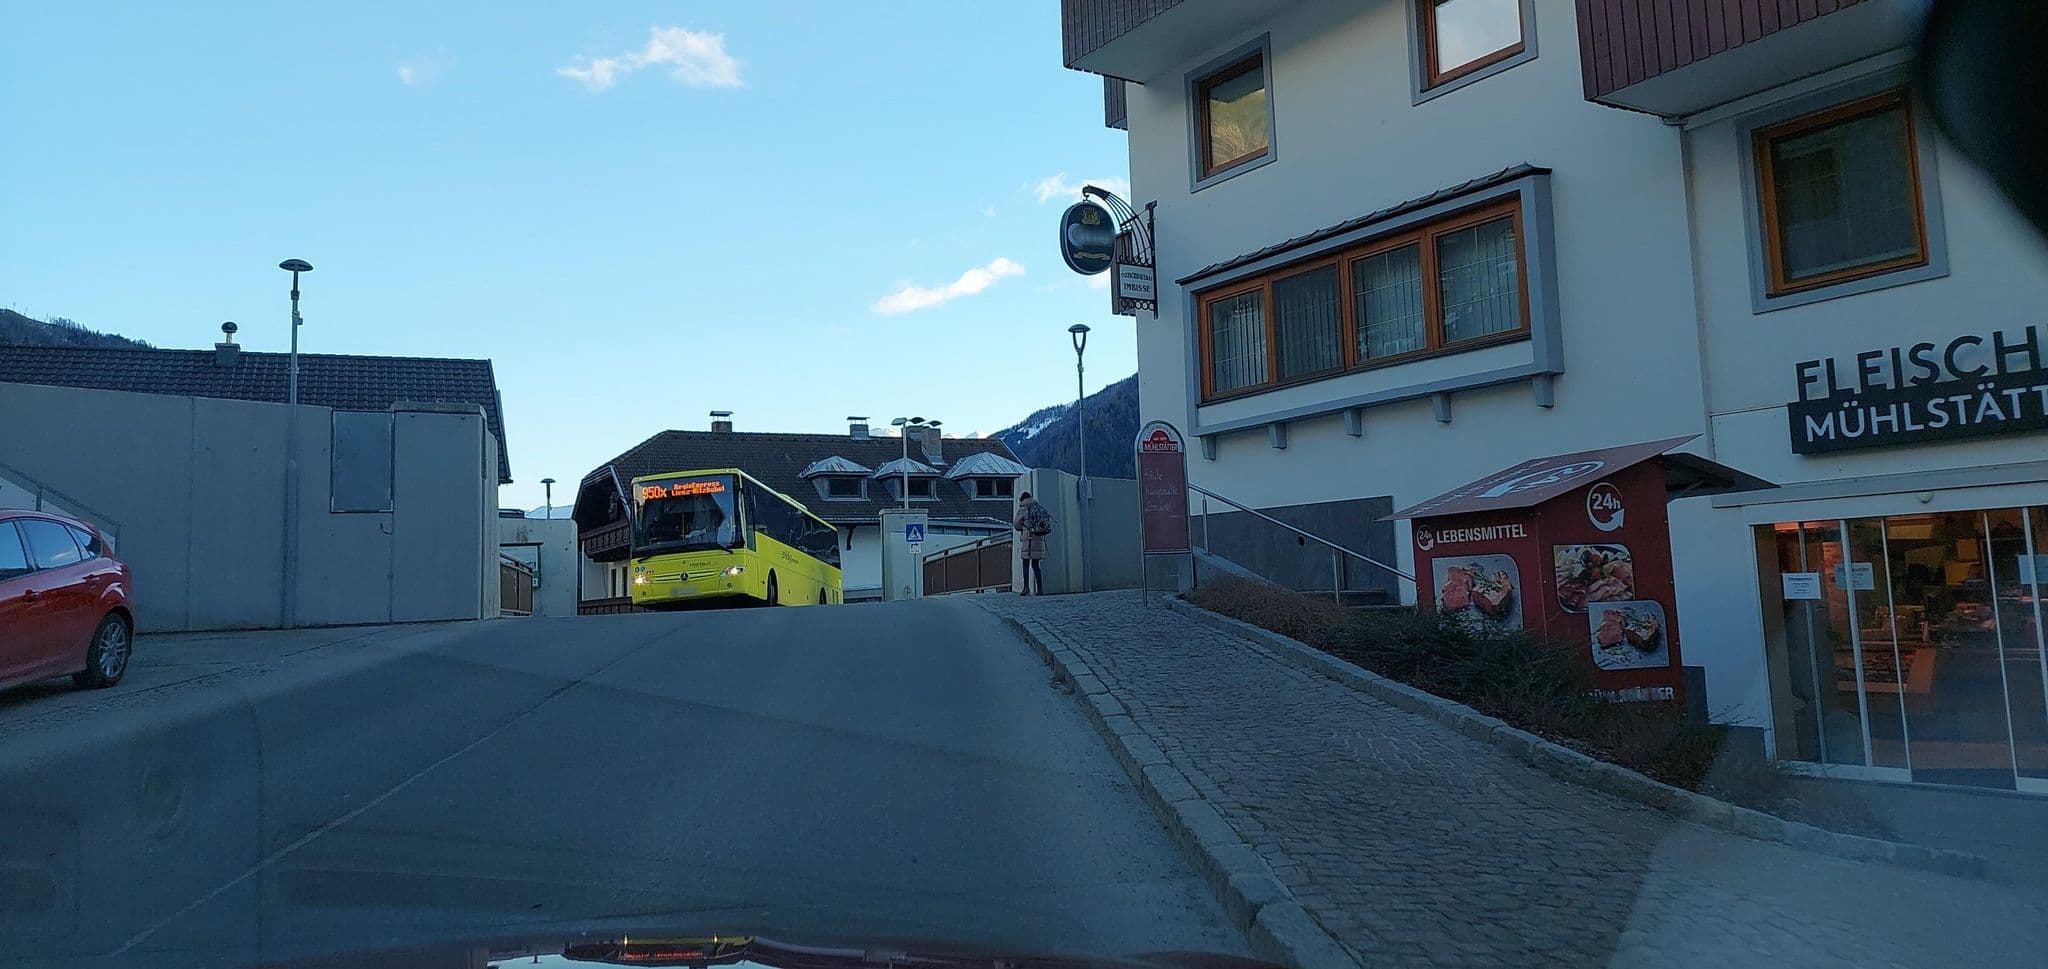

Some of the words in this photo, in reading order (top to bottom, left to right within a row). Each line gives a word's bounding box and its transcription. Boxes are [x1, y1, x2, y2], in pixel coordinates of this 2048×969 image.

[1796, 324, 2048, 402] FLEISCH
[1805, 382, 2048, 442] MÜHLSTÄTT
[1592, 492, 1621, 511] 24h
[1418, 529, 1433, 540] 24h
[1436, 523, 1528, 544] LEBENSMITTEL
